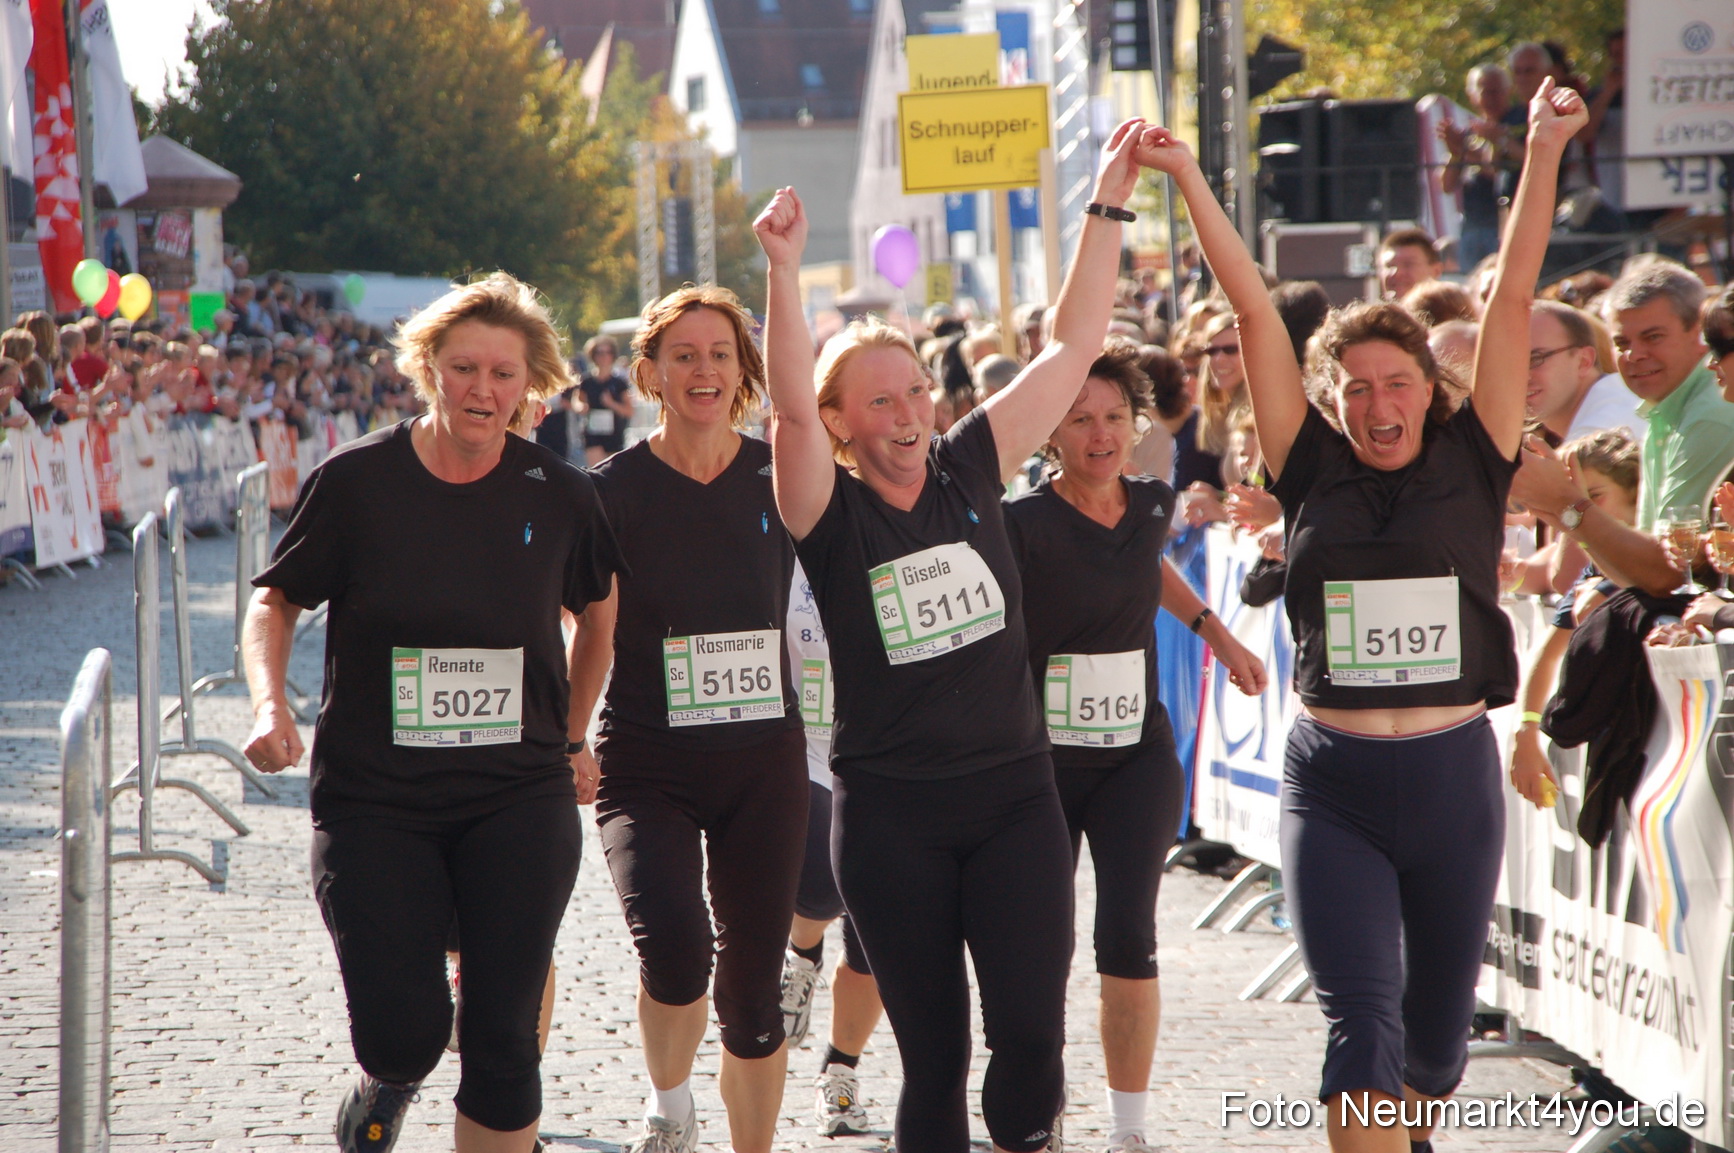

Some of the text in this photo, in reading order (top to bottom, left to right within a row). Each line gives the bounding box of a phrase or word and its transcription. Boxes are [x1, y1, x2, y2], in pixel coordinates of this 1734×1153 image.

[909, 117, 1039, 140] Schnupper-
[955, 143, 995, 165] lauf
[902, 557, 951, 586] Gisela
[881, 605, 897, 620] Sc
[917, 581, 991, 628] 5111
[695, 634, 765, 655] Rosmarie
[1366, 624, 1448, 656] 5197
[428, 656, 485, 673] Renate
[670, 667, 685, 681] Sc
[702, 665, 772, 697] 5156
[398, 686, 413, 700] Sc
[432, 688, 512, 718] 5027
[1079, 693, 1139, 721] 5164
[473, 728, 519, 739] PFLEIDERER
